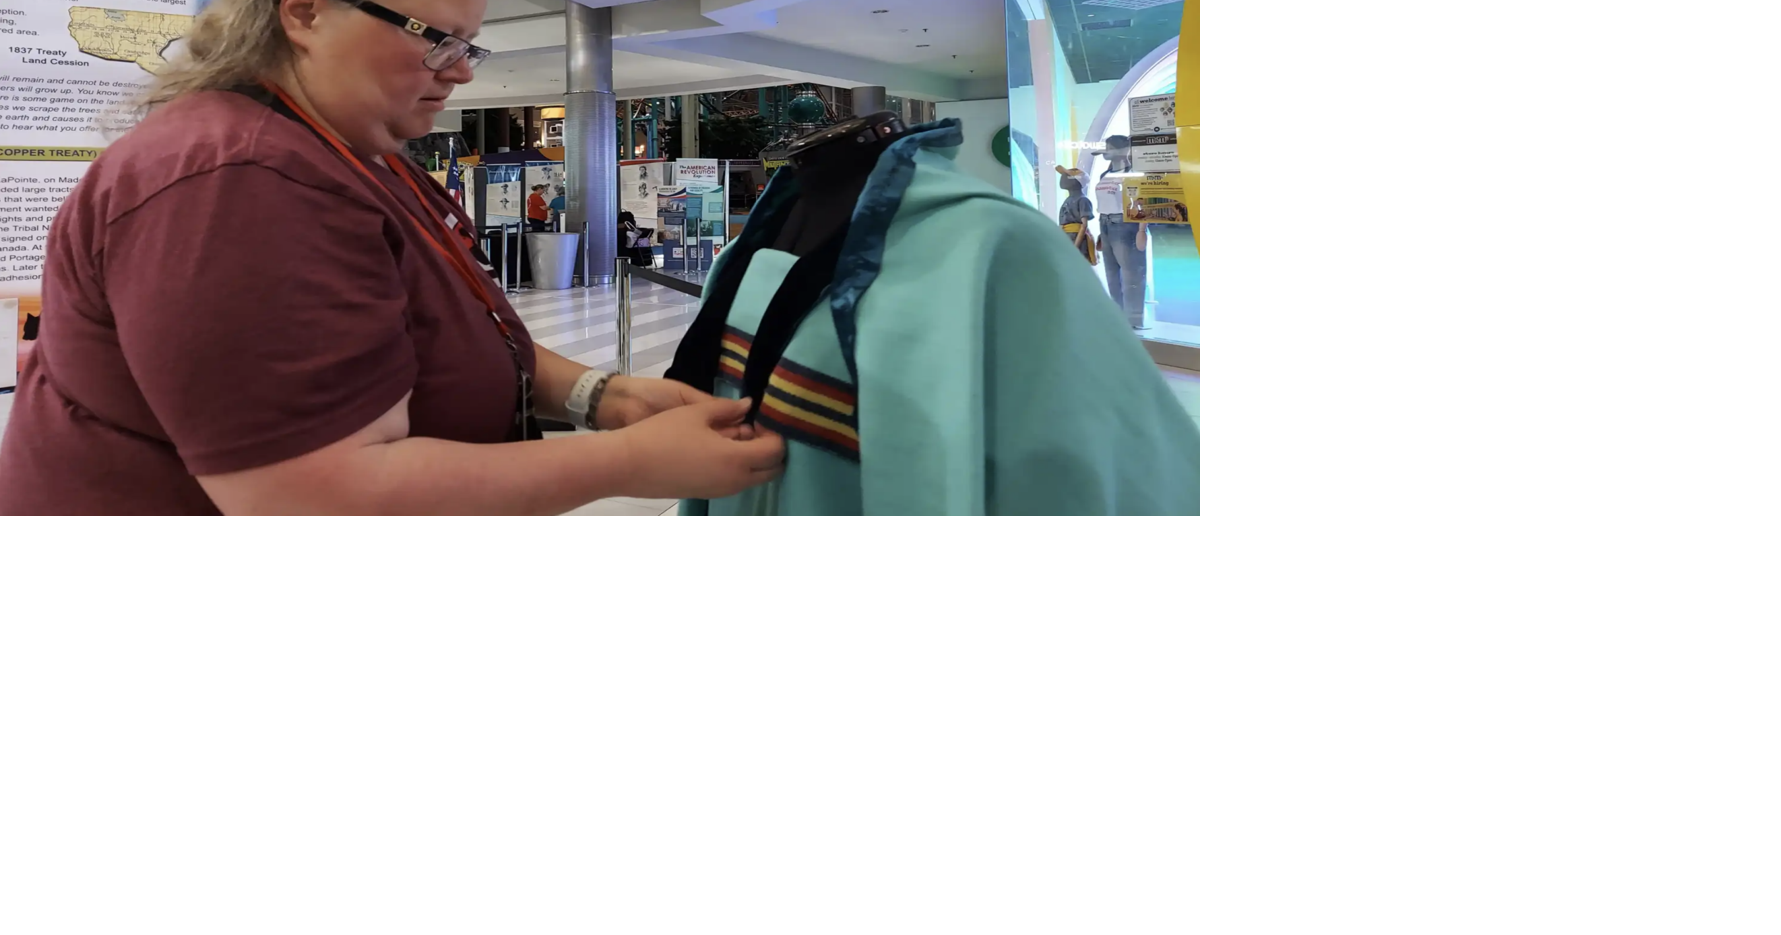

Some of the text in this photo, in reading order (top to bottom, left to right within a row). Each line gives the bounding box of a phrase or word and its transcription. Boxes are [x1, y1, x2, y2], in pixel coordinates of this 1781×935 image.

[36, 48, 67, 57] Treaty
[50, 58, 89, 66] Cession
[12, 76, 44, 84] remain
[50, 149, 97, 158] TREATY)
[1, 235, 33, 243] signed
